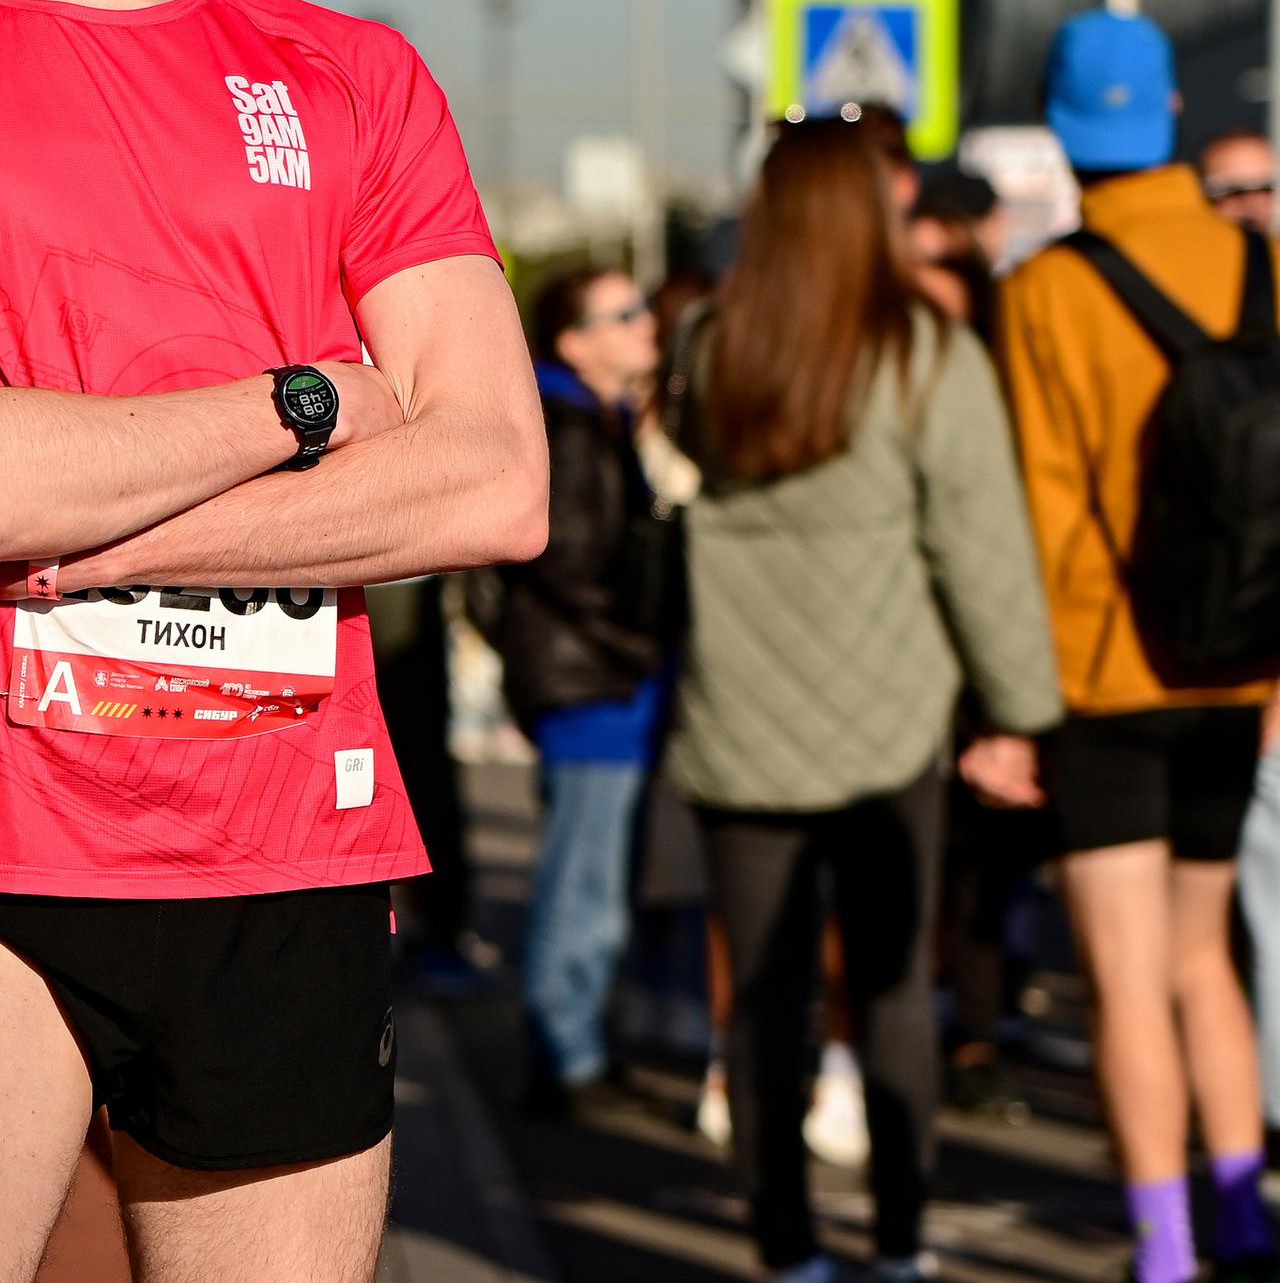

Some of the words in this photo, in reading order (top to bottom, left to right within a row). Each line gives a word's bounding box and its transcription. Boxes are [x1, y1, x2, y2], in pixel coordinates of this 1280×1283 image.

[224, 75, 298, 117] Sat
[237, 113, 308, 151] 9AM
[245, 145, 312, 191] 5KM
[136, 619, 226, 650] ТИХОН
[193, 709, 239, 721] СИБУР
[344, 758, 365, 772] GRi
